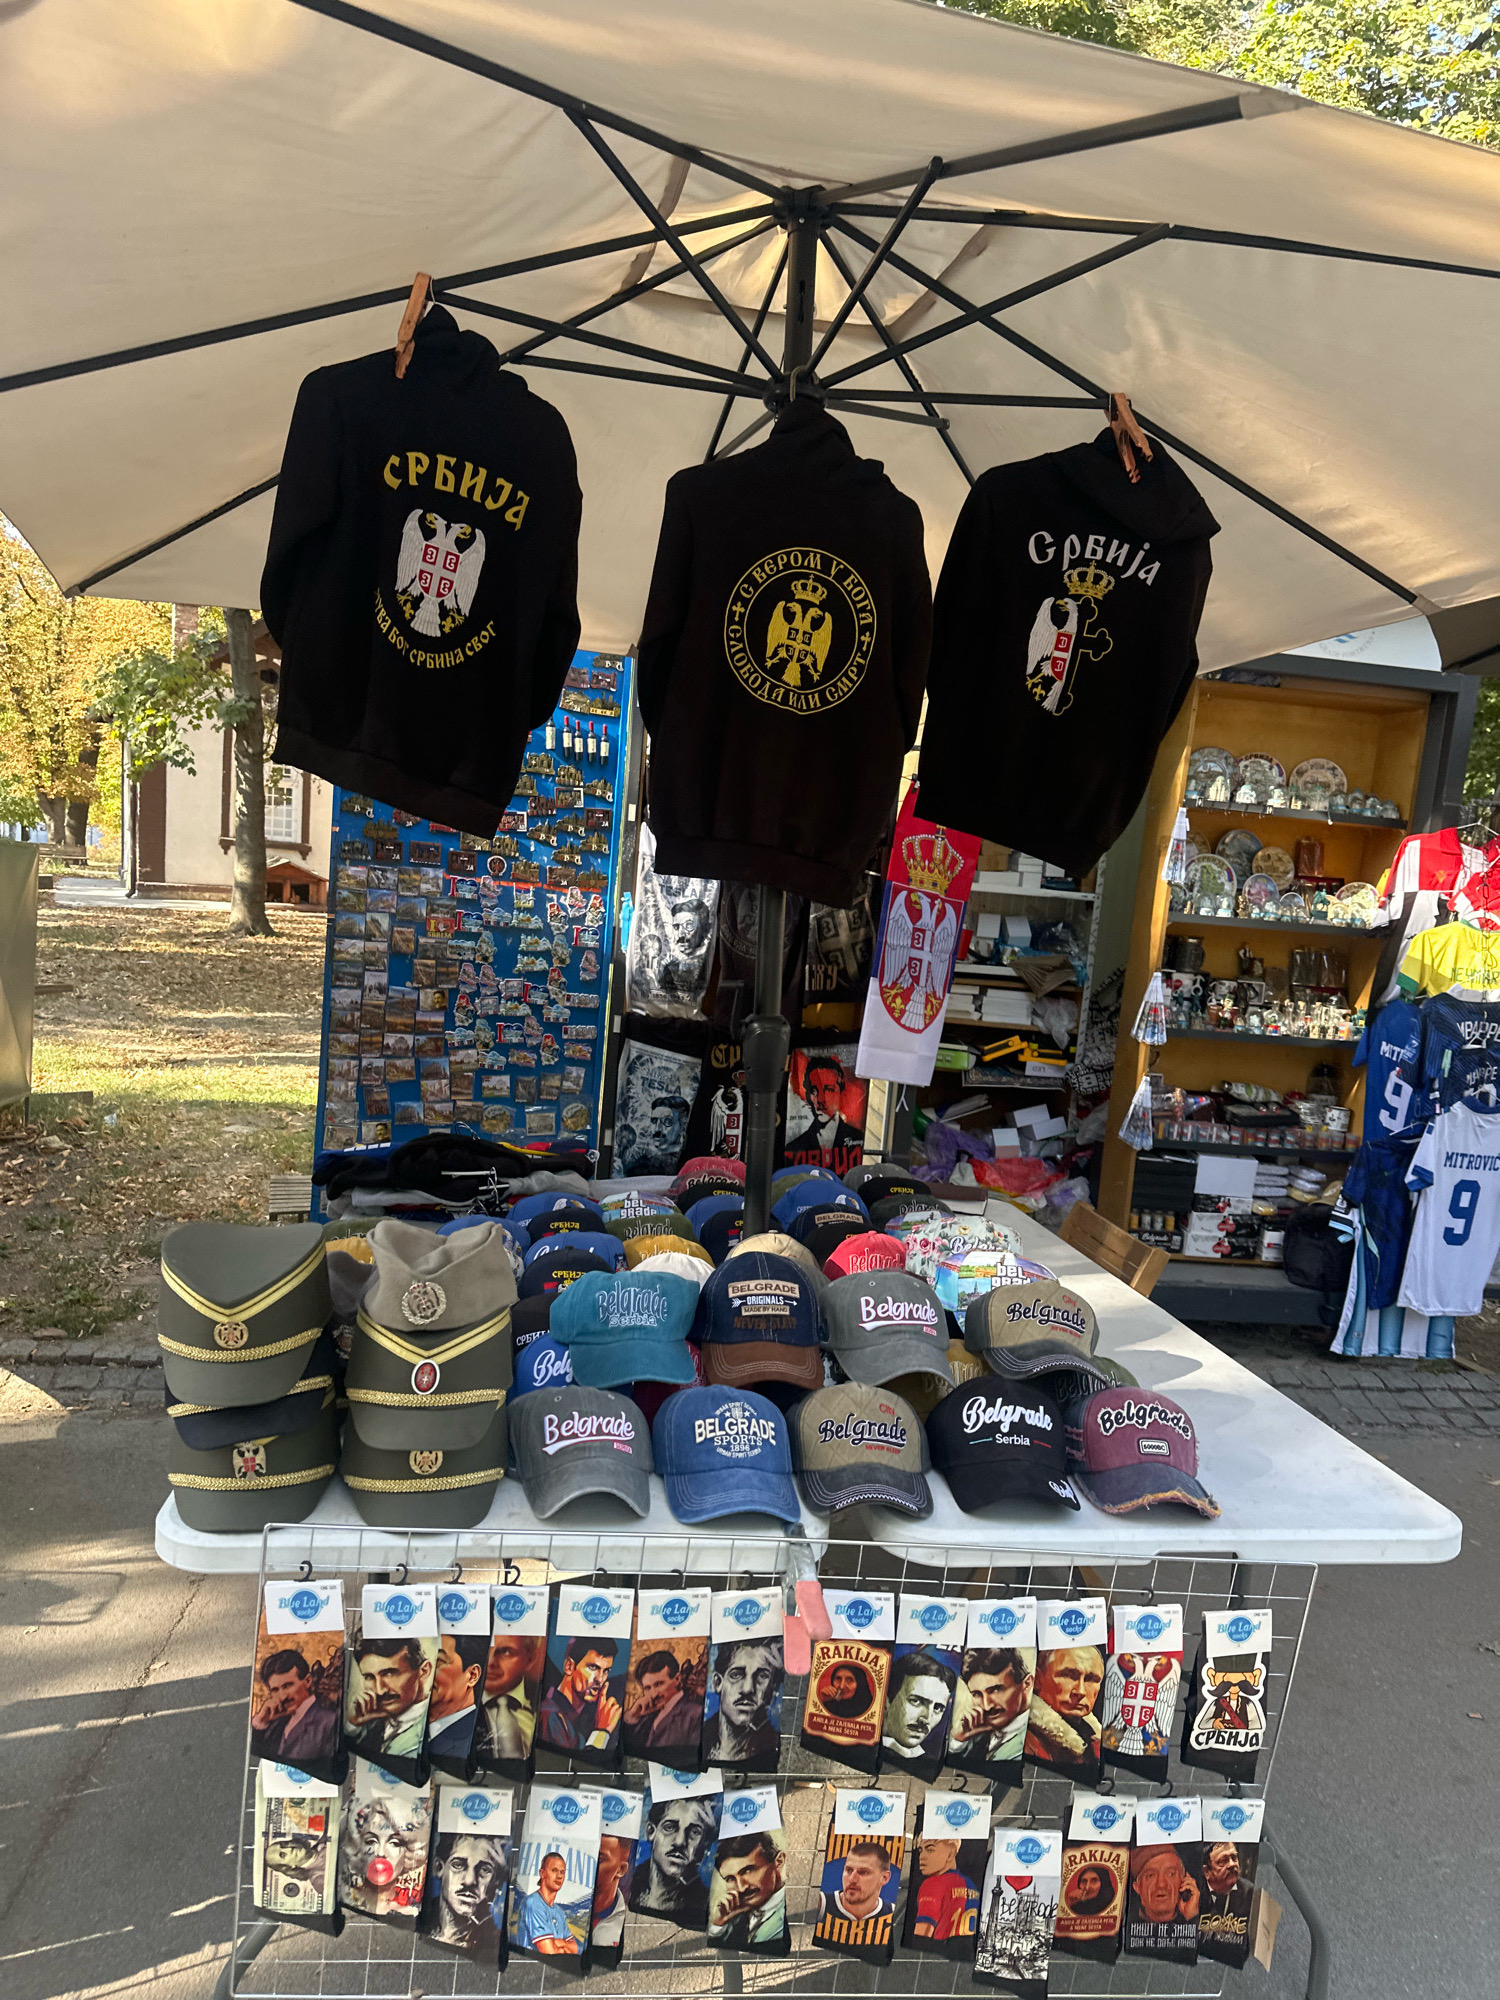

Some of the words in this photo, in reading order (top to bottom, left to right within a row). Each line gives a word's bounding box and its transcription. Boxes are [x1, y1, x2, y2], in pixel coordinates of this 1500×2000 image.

[383, 452, 530, 531] СРБИЈА
[409, 647, 465, 668] СРБИНА
[465, 620, 496, 656] СВОГ
[640, 1076, 682, 1096] TESLA
[1379, 1069, 1414, 1132] 9
[1443, 1179, 1481, 1246] 9
[732, 1283, 797, 1294] BELGRADE
[595, 1281, 668, 1322] Belgrade
[746, 1295, 784, 1305] ORIGINALS
[860, 1296, 938, 1323] Belgrade
[1006, 1299, 1086, 1334] Belgrade
[962, 1396, 1053, 1433] Belgrade
[1098, 1400, 1192, 1440] Belgrade
[544, 1411, 635, 1445] Belgrade
[694, 1418, 777, 1446] BELGRADE
[818, 1412, 907, 1448] Belgrade
[714, 1435, 762, 1446] SPORTS
[995, 1433, 1031, 1447] Serbia
[279, 1597, 300, 1609] Blue
[302, 1595, 330, 1609] Land
[374, 1601, 395, 1613] Blue
[398, 1600, 424, 1614] Land
[452, 1600, 478, 1614] Land
[509, 1601, 536, 1613] Land
[570, 1601, 592, 1612] Blue
[594, 1601, 622, 1615] Land
[651, 1605, 672, 1616] Blue
[674, 1603, 700, 1615] Land
[723, 1606, 744, 1617] Blue
[746, 1603, 771, 1615] Land
[834, 1604, 856, 1616] Blue
[858, 1605, 883, 1618] Land
[910, 1609, 931, 1620] Blue
[932, 1610, 957, 1621] Land
[979, 1613, 1000, 1624] Blue
[1001, 1613, 1025, 1625] Land
[1049, 1616, 1070, 1626] Blue
[1071, 1614, 1096, 1626] Land
[1126, 1620, 1146, 1630] Blue
[1147, 1619, 1171, 1631] Land
[1217, 1623, 1237, 1634] Blue
[1238, 1621, 1261, 1634] Land
[820, 1645, 880, 1668] RAKIJA
[1194, 1731, 1260, 1747] СРБИЈА
[451, 1798, 472, 1808] Blue
[474, 1798, 500, 1811] Land
[541, 1800, 562, 1812] Blue
[563, 1801, 590, 1816] Land
[609, 1800, 635, 1815] Land
[742, 1800, 767, 1813] Land
[847, 1800, 868, 1811] Blue
[870, 1801, 895, 1814] Land
[935, 1806, 955, 1816] Blue
[956, 1805, 981, 1818] Land
[1083, 1809, 1101, 1819] Blue
[1103, 1810, 1126, 1822] Land
[1147, 1812, 1167, 1822] Blue
[1168, 1810, 1191, 1822] Land
[1211, 1811, 1230, 1820] Blue
[1231, 1811, 1254, 1822] Land
[1006, 1843, 1026, 1853] Blue
[1027, 1843, 1051, 1855] Land
[1068, 1850, 1121, 1868] RAKIJA
[950, 1907, 978, 1937] 10
